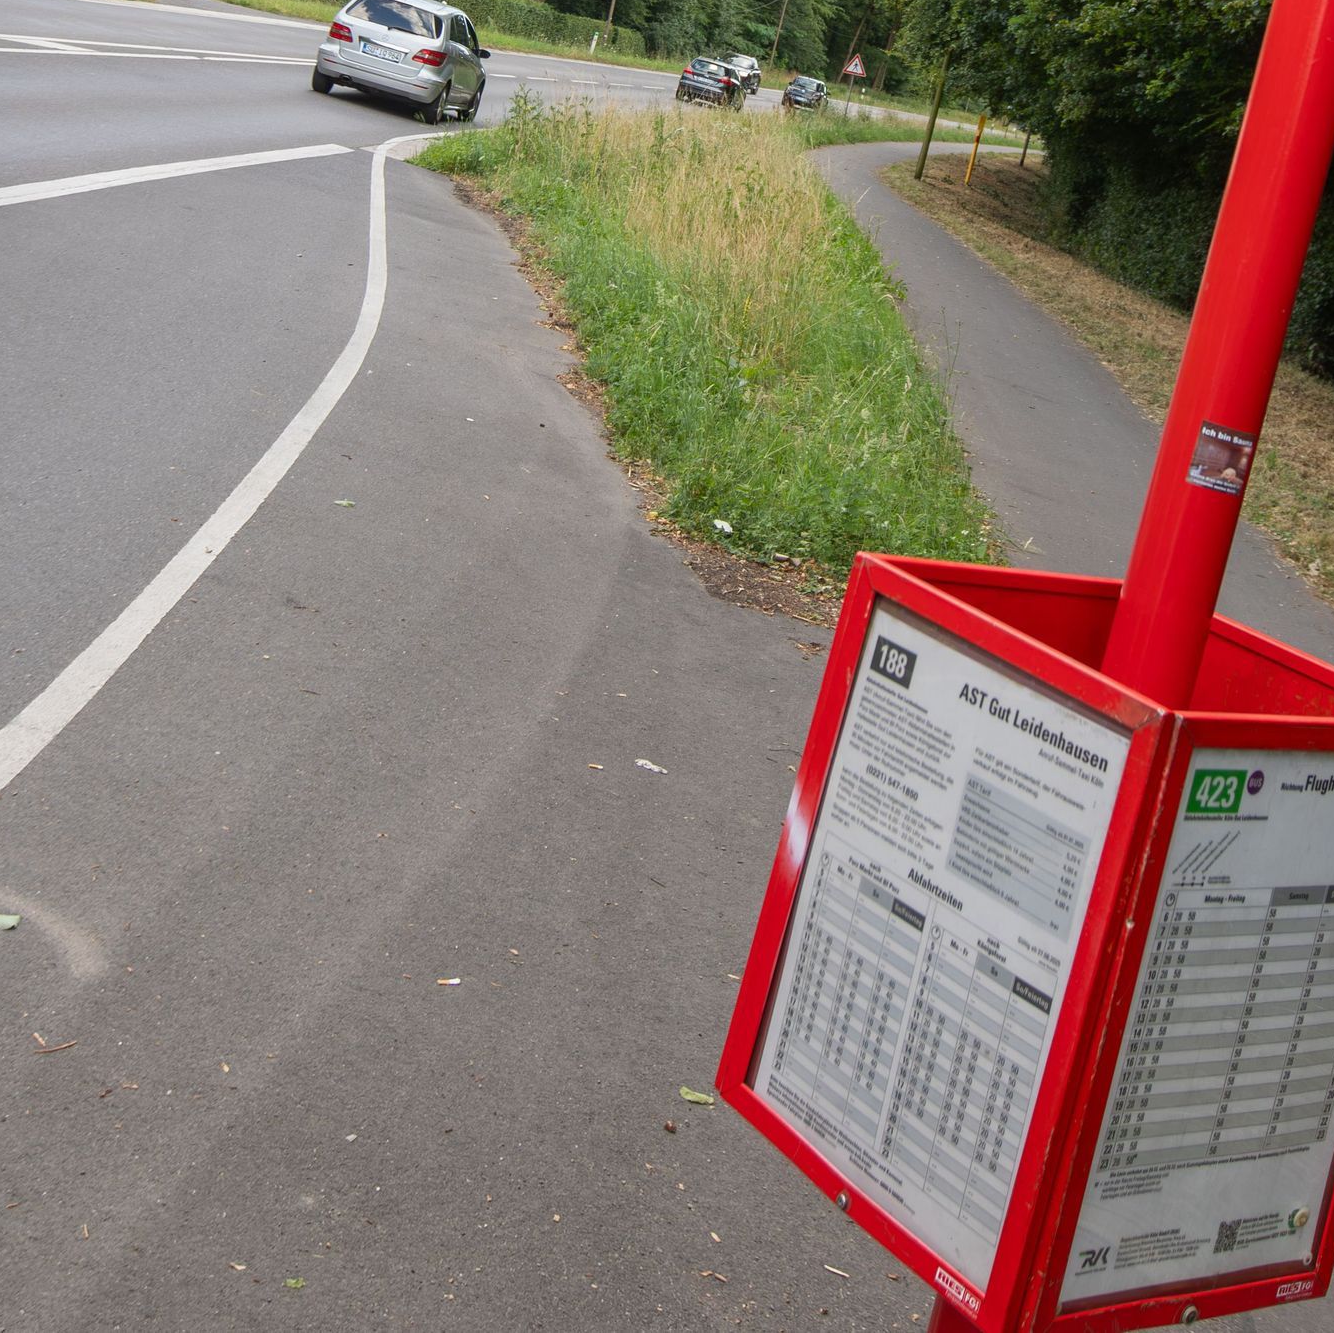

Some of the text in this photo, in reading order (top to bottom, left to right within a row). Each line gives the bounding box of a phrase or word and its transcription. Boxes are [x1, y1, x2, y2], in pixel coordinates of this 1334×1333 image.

[1202, 426, 1217, 438] Ich
[1217, 431, 1231, 442] bin
[879, 645, 908, 678] 188
[959, 683, 988, 709] AST
[989, 698, 1011, 723] Gut
[1013, 710, 1108, 773] Leidenhausen
[866, 764, 887, 784] (0221)
[1196, 776, 1238, 808] 423
[908, 868, 963, 911] Abfahrtzeiten
[1204, 895, 1224, 904] Montag
[1228, 894, 1246, 904] Freitag
[1163, 912, 1169, 922] 6
[1160, 926, 1166, 936] 7
[1153, 955, 1158, 966] 9
[925, 964, 930, 973] 7
[1148, 970, 1157, 980] 10
[1144, 985, 1152, 995] 11
[1016, 982, 1049, 1010] So/Feiertag
[1141, 999, 1149, 1009] 12
[1137, 1013, 1146, 1024] 13
[1133, 1028, 1142, 1039] 14
[1130, 1042, 1138, 1053] 15
[1126, 1057, 1135, 1068] 16
[1122, 1071, 1131, 1082] 17
[1119, 1086, 1127, 1097] 18
[1115, 1101, 1124, 1111] 19
[1110, 1114, 1120, 1126] 20
[1107, 1130, 1116, 1140] 21
[1103, 1144, 1113, 1155] 22
[1099, 1159, 1109, 1170] 23
